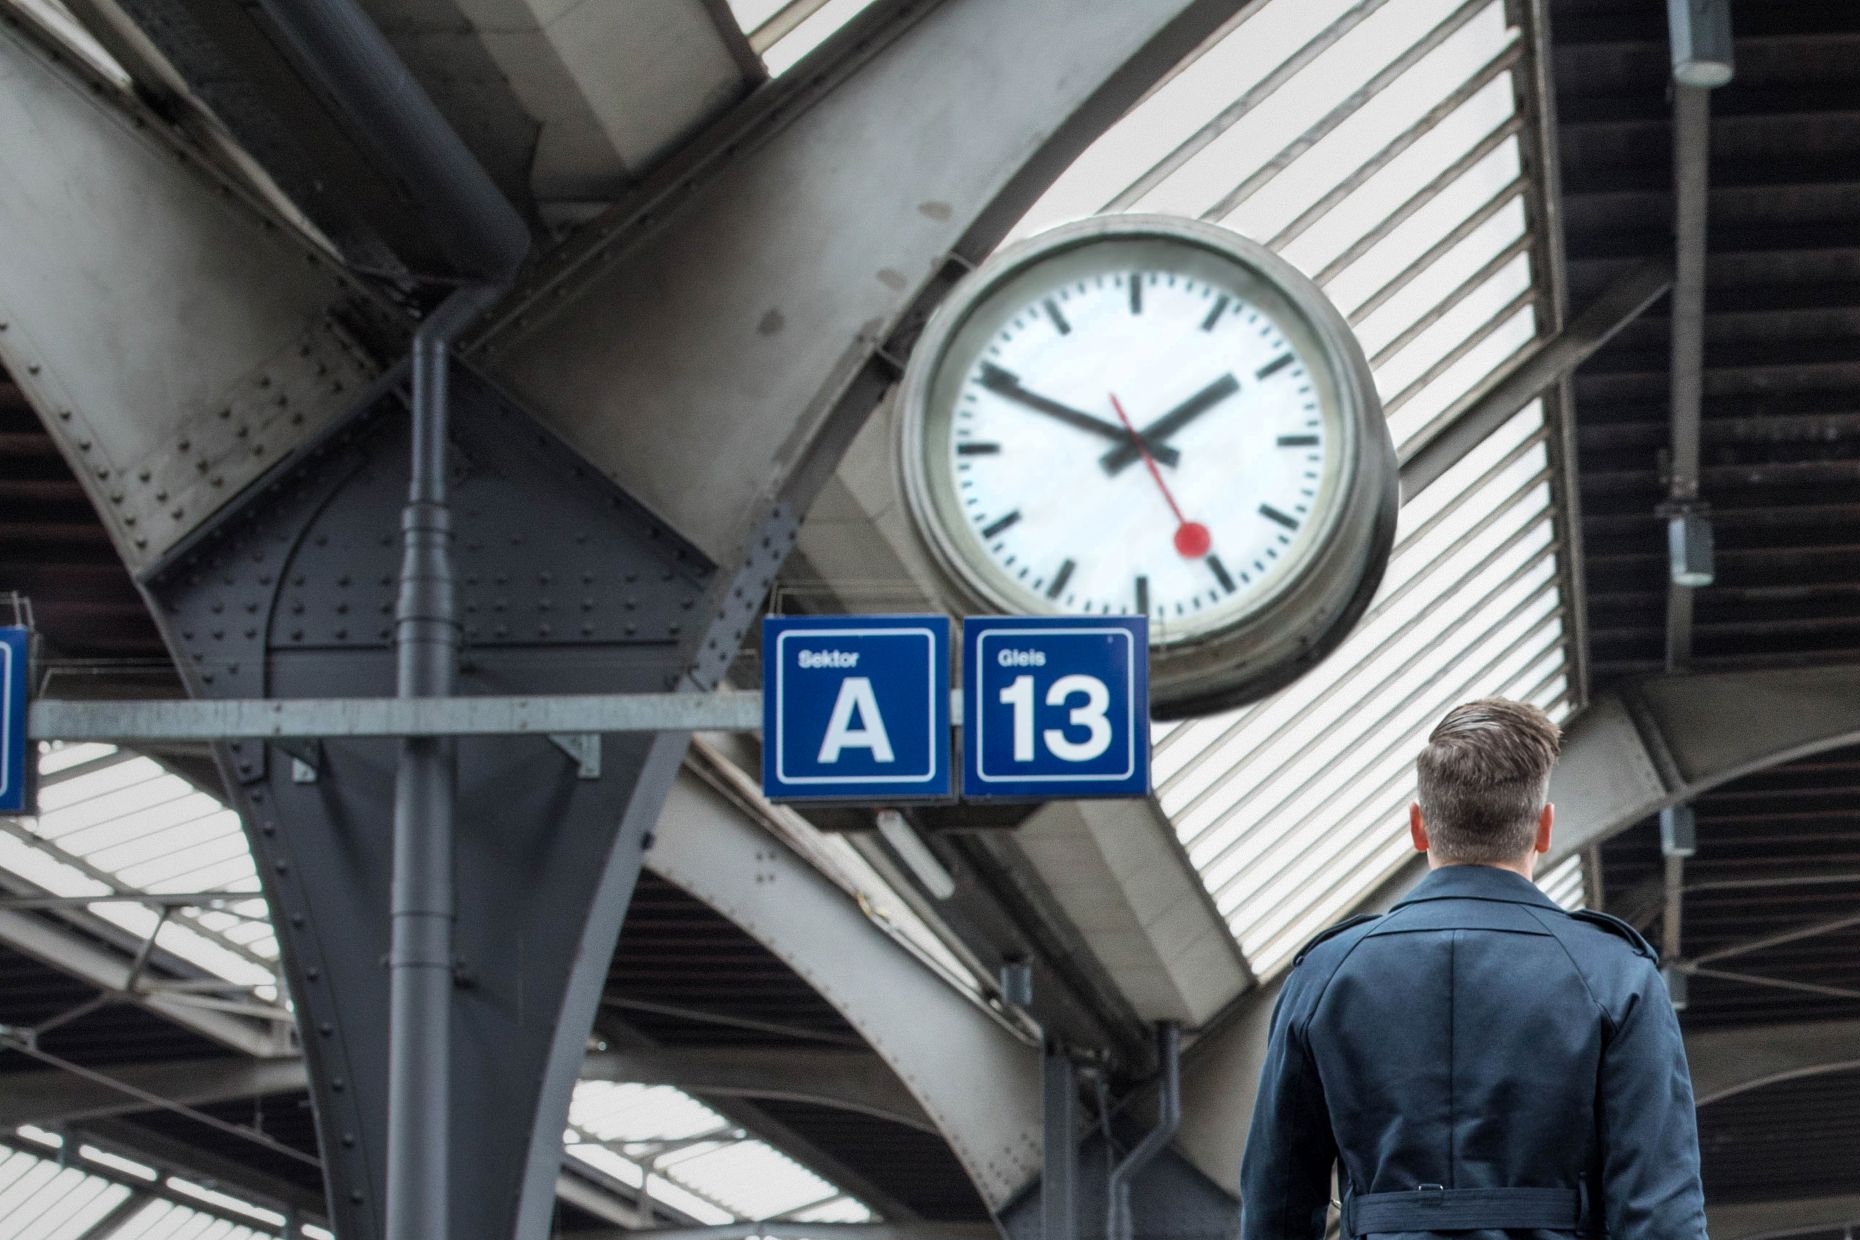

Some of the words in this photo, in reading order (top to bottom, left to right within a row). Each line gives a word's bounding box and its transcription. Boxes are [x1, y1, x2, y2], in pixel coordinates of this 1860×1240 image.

[798, 650, 859, 669] Sektor
[998, 649, 1046, 667] Gleis
[817, 677, 895, 763] A
[1000, 674, 1112, 762] 13
